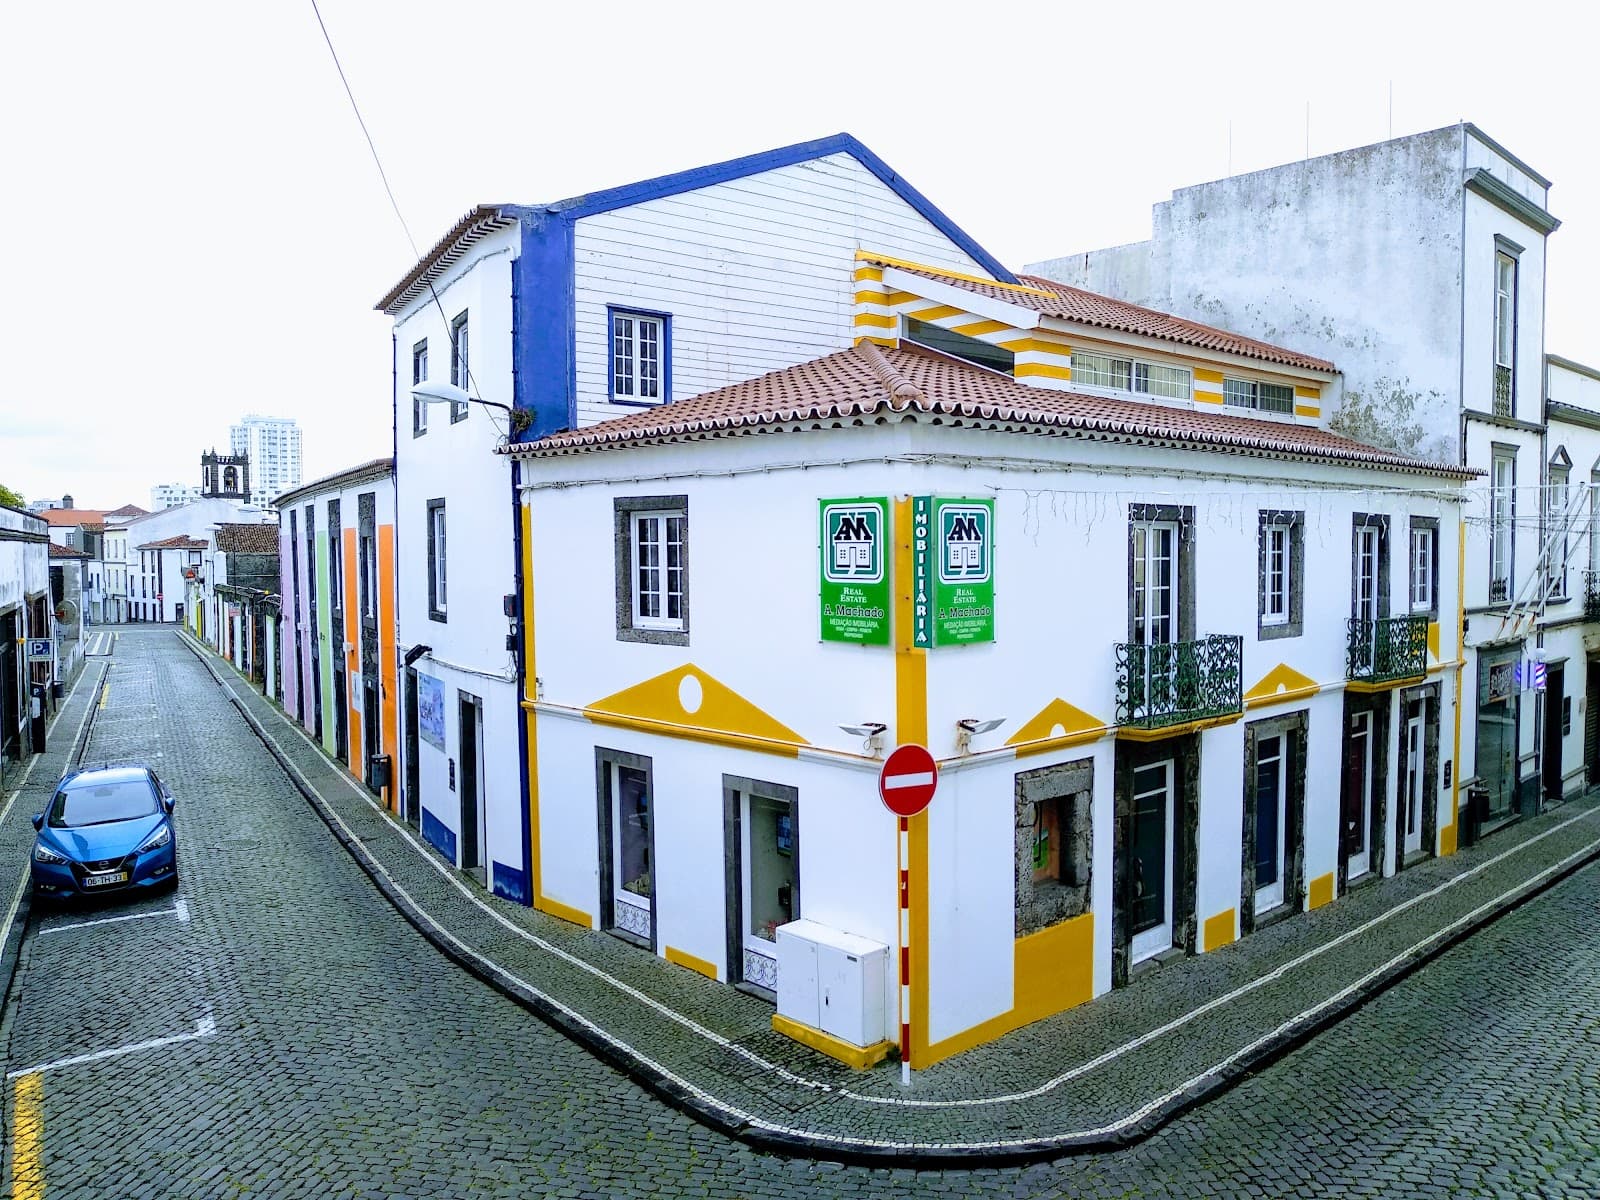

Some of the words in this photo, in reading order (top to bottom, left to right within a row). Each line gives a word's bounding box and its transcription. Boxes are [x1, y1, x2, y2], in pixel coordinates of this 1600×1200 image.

[915, 500, 929, 643] IMOBILIÁRIA
[843, 587, 863, 595] REAL
[840, 595, 867, 603] ESTATE
[953, 596, 977, 604] ESTATE
[835, 604, 884, 619] Machado
[949, 605, 992, 619] Machado
[33, 643, 43, 655] P
